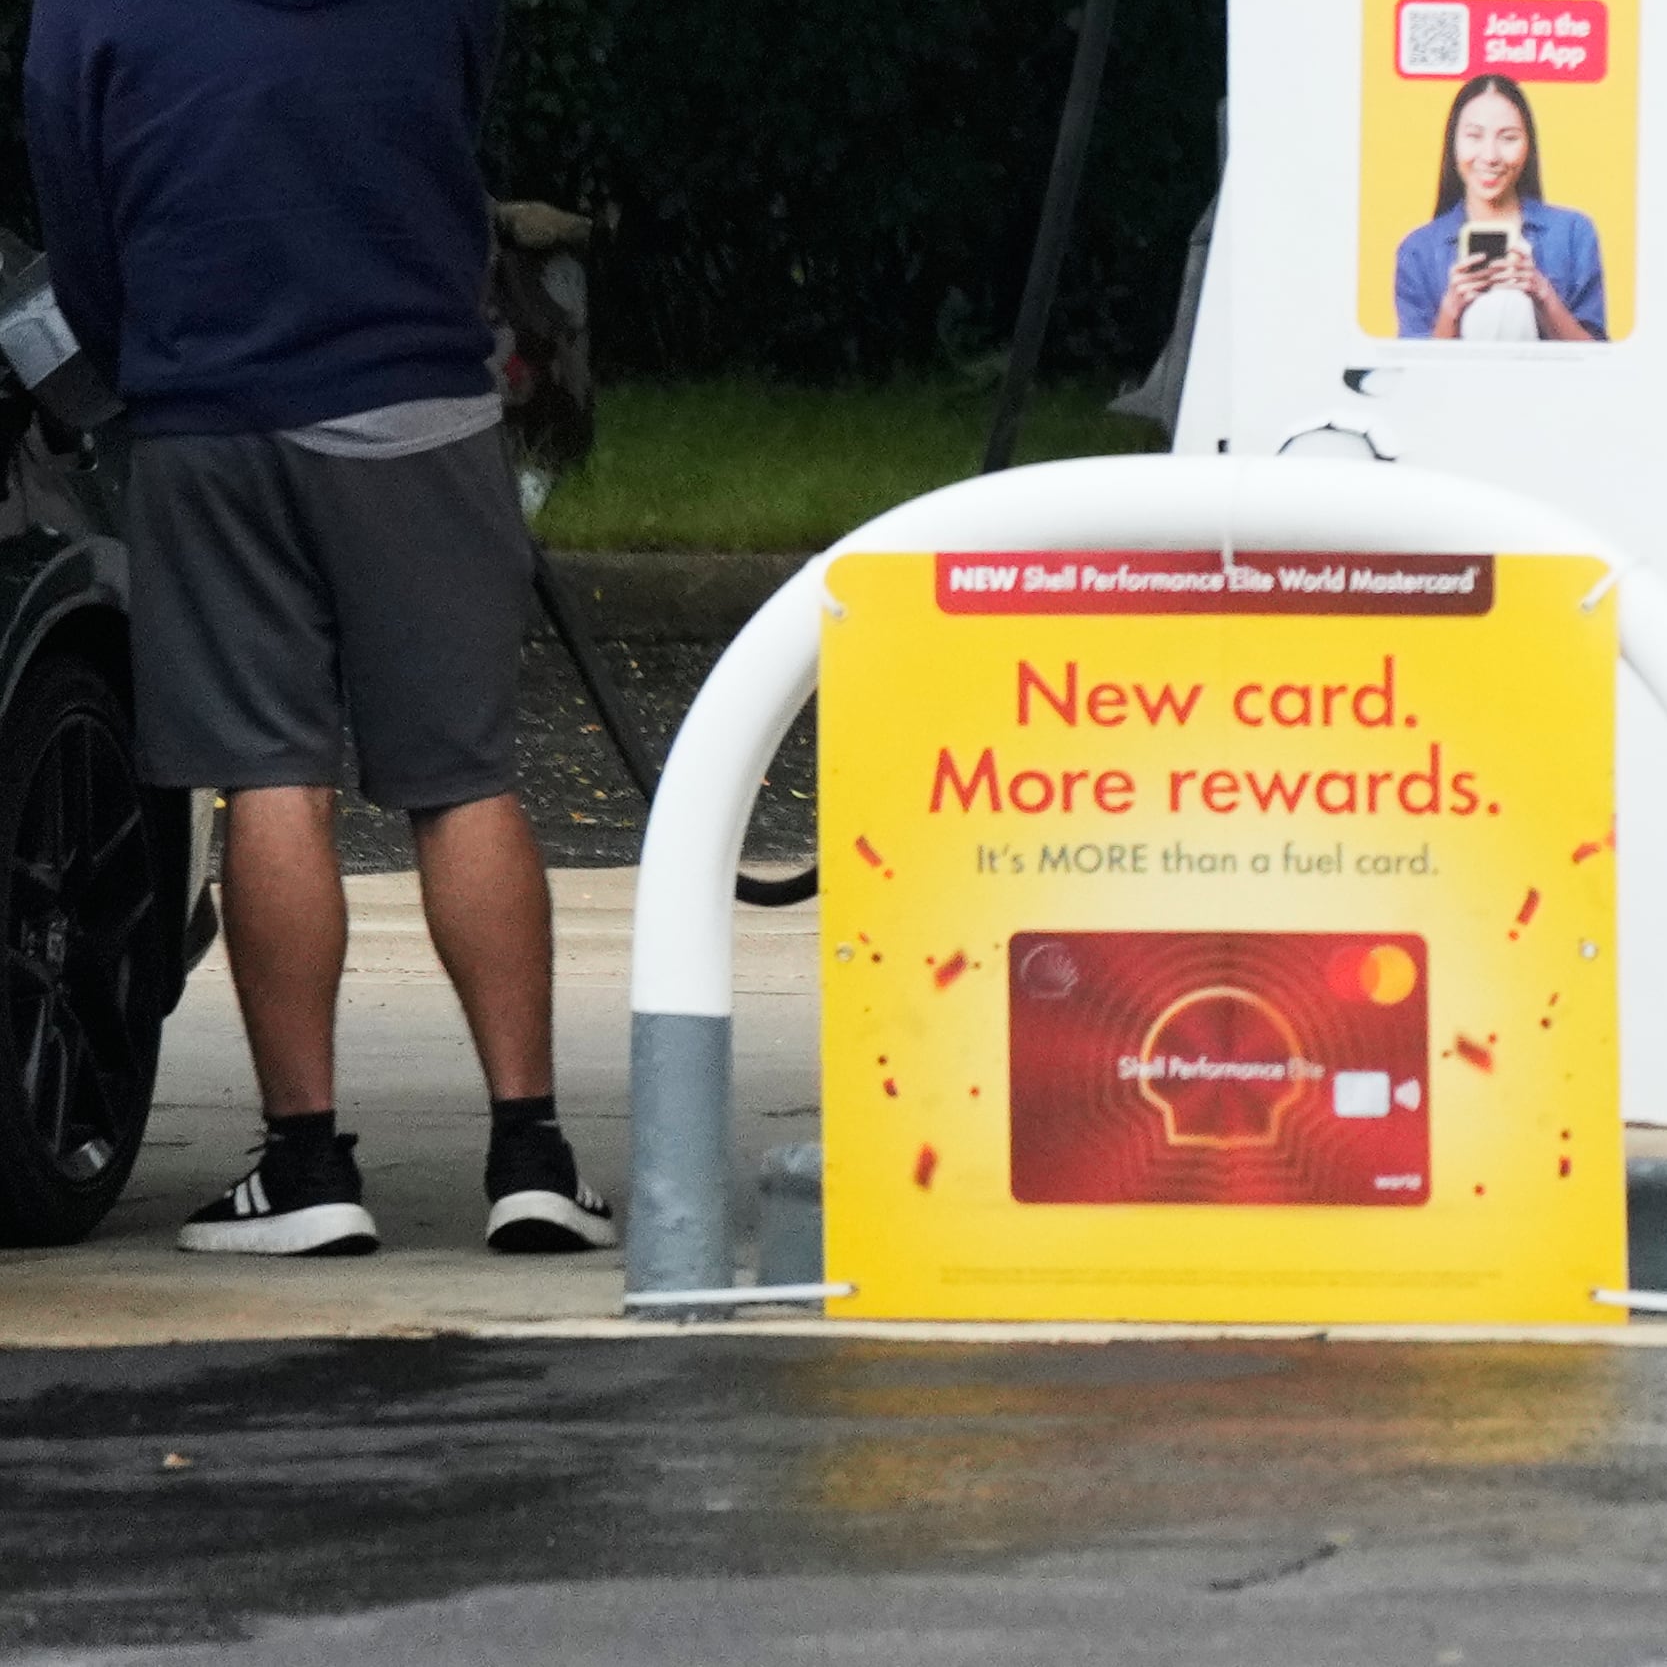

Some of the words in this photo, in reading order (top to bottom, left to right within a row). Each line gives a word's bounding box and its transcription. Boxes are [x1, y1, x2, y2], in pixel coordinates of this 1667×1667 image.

[1484, 12, 1529, 36] Join
[1531, 13, 1552, 36] in
[1554, 12, 1591, 38] the
[1485, 38, 1537, 63] Shell
[1538, 40, 1586, 69] App
[950, 566, 1018, 593] NEW
[1023, 565, 1077, 593] Shell
[1081, 565, 1225, 593] Performance
[1278, 565, 1345, 593] World
[1016, 658, 1204, 729] New
[1232, 654, 1418, 729] card.
[928, 747, 1136, 817] More
[1167, 742, 1502, 817] rewards.
[976, 844, 1026, 876] It's
[1037, 843, 1148, 875] MORE
[1161, 842, 1237, 876] than
[1251, 853, 1272, 876] a
[1282, 842, 1344, 876] fuel
[1354, 842, 1440, 876] card.
[1168, 1055, 1285, 1080] Performance
